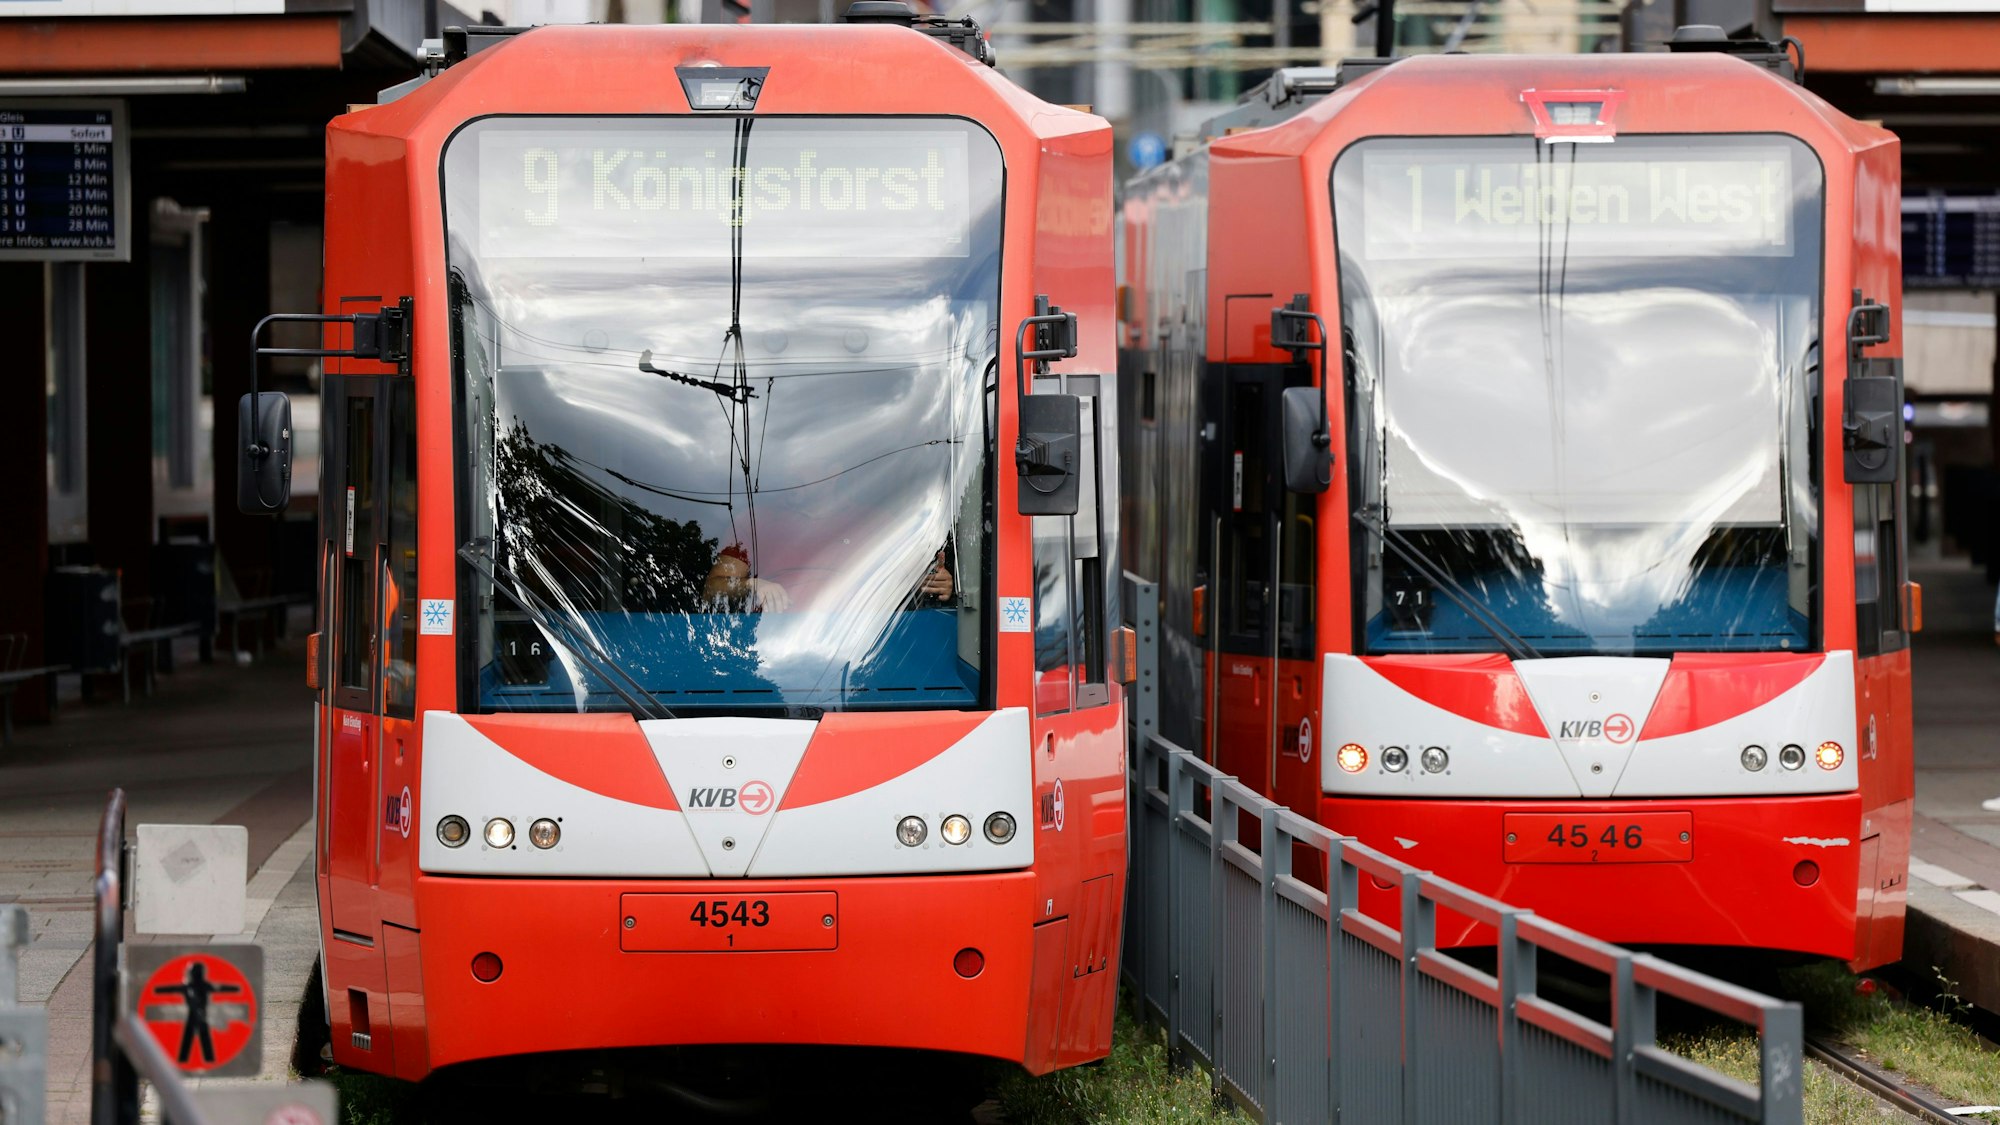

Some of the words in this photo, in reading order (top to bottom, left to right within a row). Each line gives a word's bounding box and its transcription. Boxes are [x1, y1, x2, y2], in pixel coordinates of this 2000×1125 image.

[0, 113, 24, 123] Gleis
[96, 113, 106, 123] in
[71, 129, 106, 139] Sofort
[74, 143, 81, 154] 5
[84, 143, 107, 154] Min
[74, 158, 81, 170] 8
[84, 158, 107, 170] Min
[68, 174, 81, 185] 12
[85, 174, 107, 185] Min
[523, 148, 559, 227] 9
[593, 149, 945, 227] Königsforst
[68, 189, 82, 200] 13
[85, 189, 108, 200] Min
[1406, 165, 1423, 233] 1
[1455, 168, 1629, 225] Weiden
[1650, 167, 1777, 224] West
[69, 204, 83, 216] 20
[86, 204, 108, 216] Min
[69, 219, 83, 231] 28
[86, 219, 108, 231] Min
[1559, 720, 1602, 738] KVB
[688, 788, 737, 808] KVB
[386, 795, 401, 825] KVB
[1591, 850, 1599, 862] 2
[690, 900, 770, 928] 4543
[726, 933, 734, 947] 1
